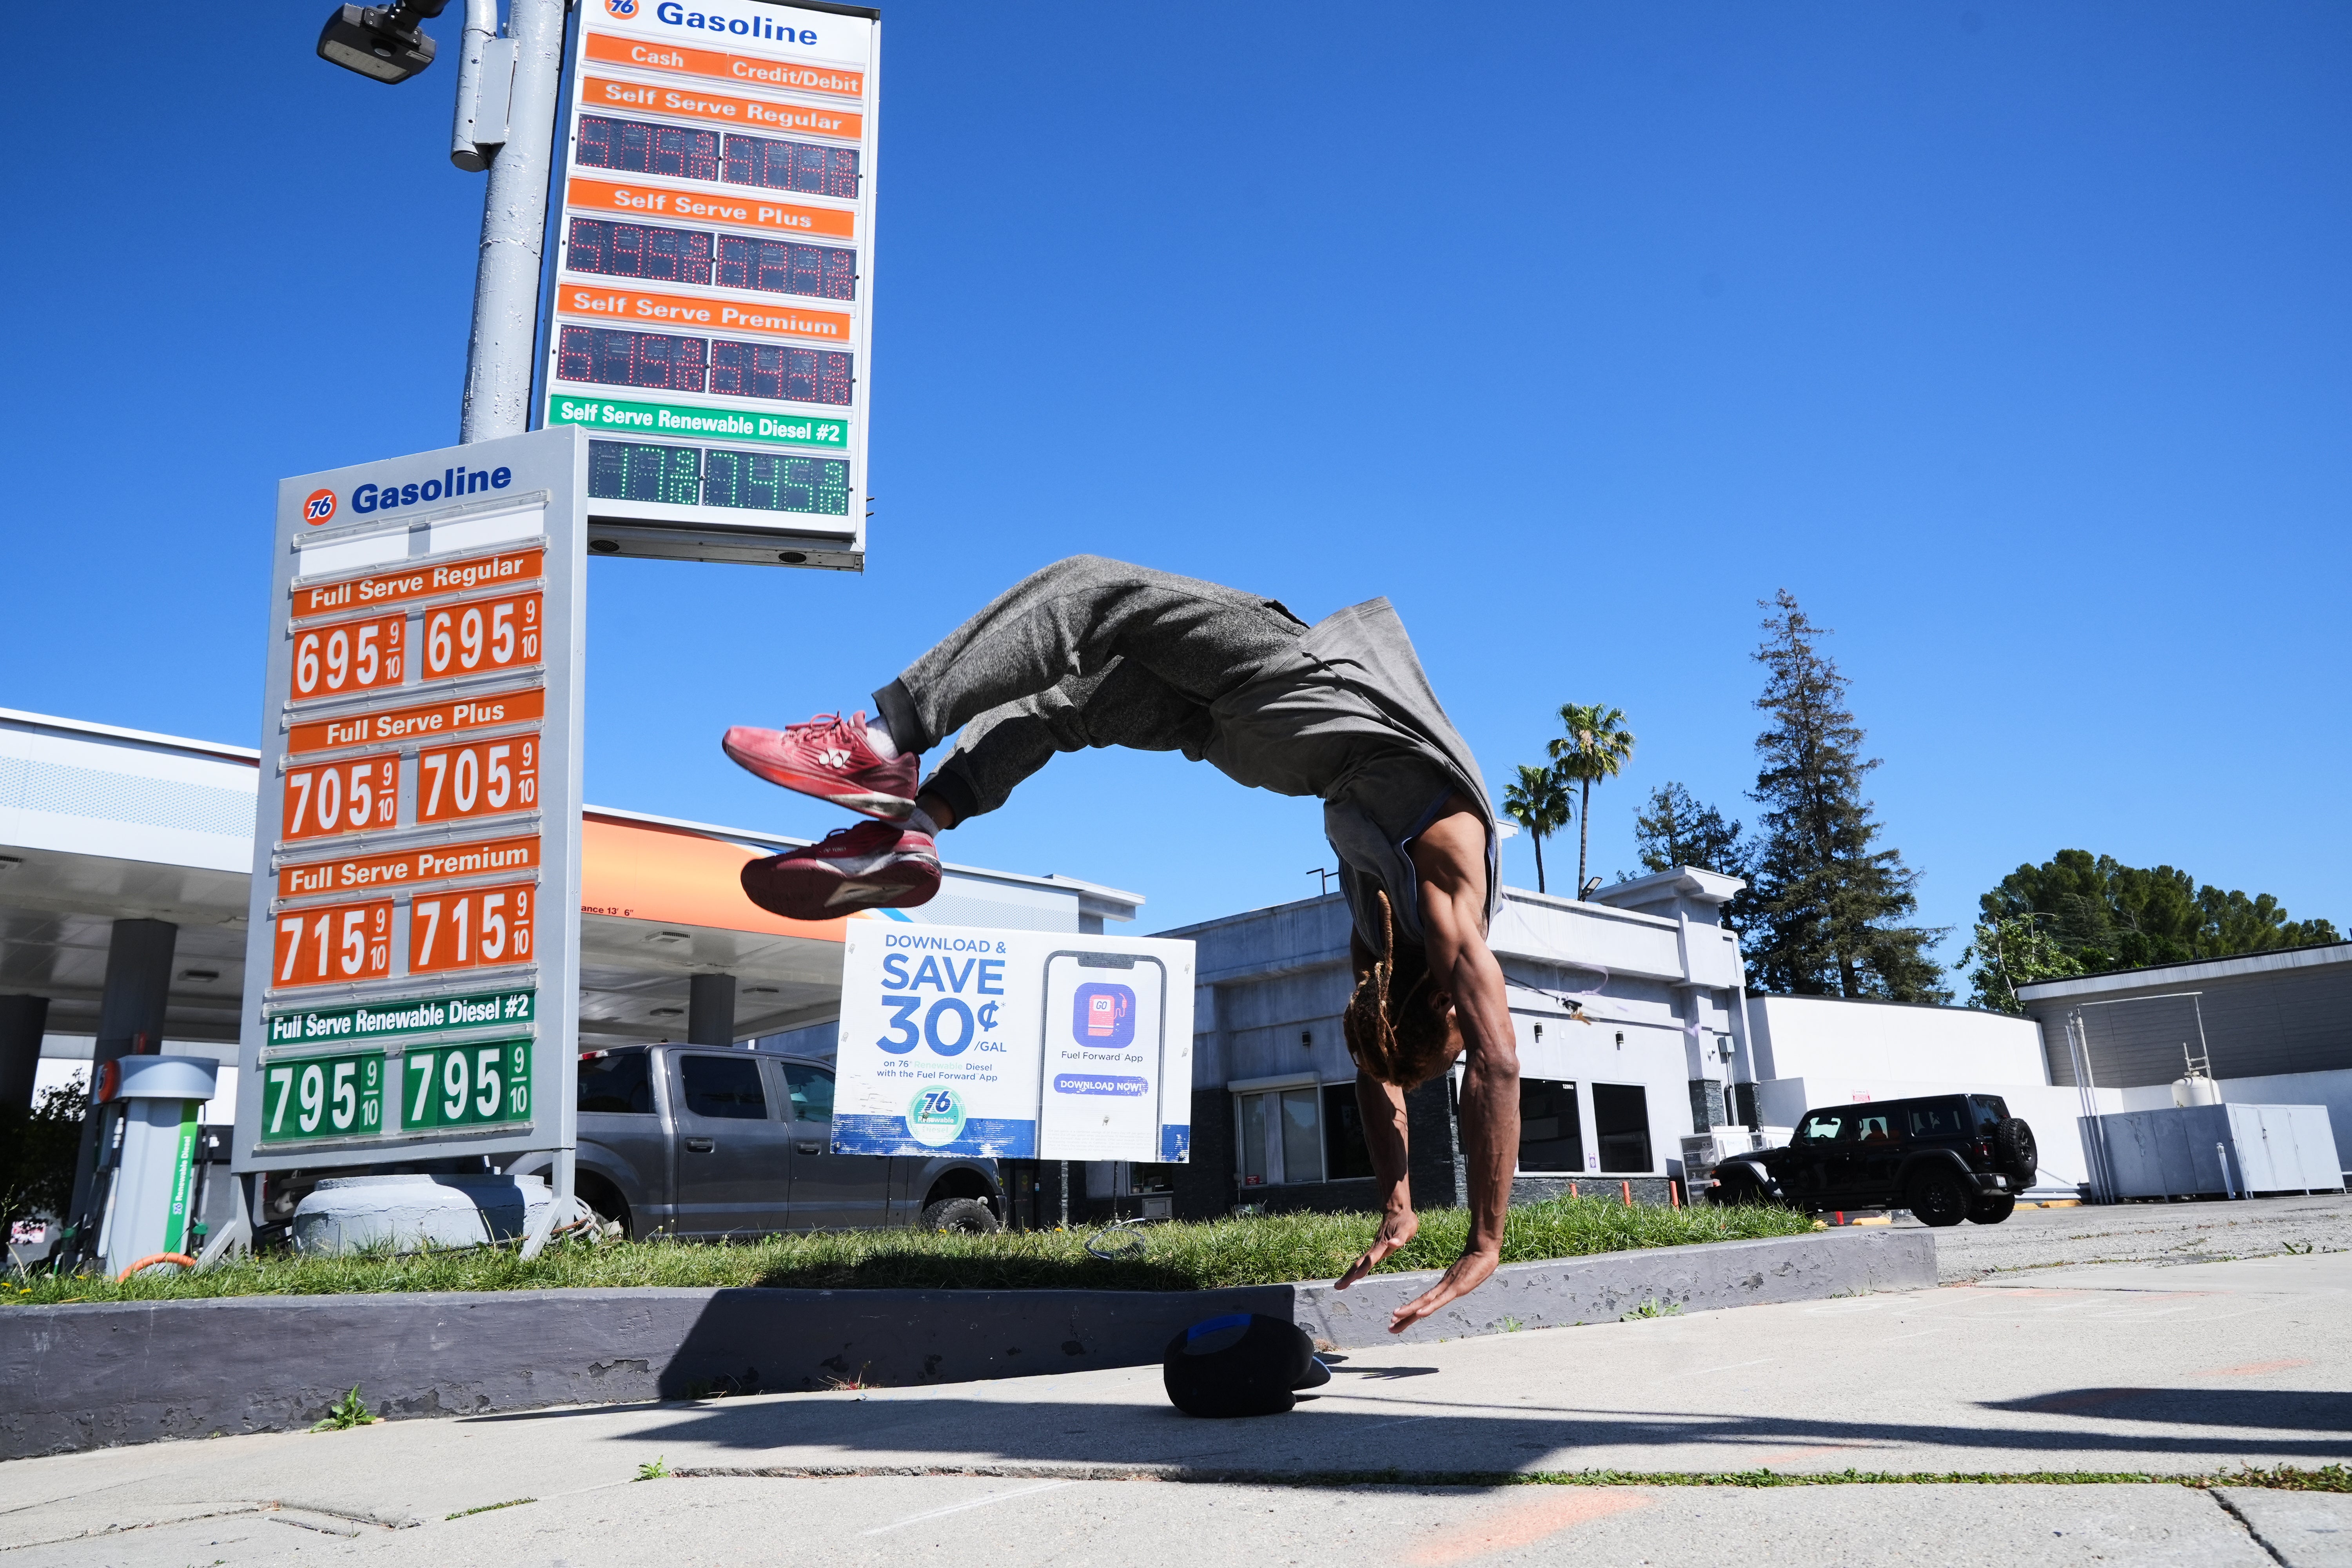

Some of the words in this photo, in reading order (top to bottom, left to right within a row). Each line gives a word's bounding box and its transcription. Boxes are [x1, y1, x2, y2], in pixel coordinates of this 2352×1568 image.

[609, 0, 634, 14] 76
[657, 2, 817, 45] Gasoline
[632, 46, 683, 67] Cash
[733, 62, 858, 91] Credit/Debit
[606, 84, 656, 104] Self
[666, 93, 736, 116] Serve
[748, 104, 842, 129] Regular
[615, 190, 666, 210] Self
[675, 197, 746, 220] Serve
[759, 207, 811, 227] Plus
[574, 292, 627, 312] Self
[637, 299, 710, 321] Serve
[722, 307, 837, 334] Premium
[561, 402, 598, 421] Self
[603, 405, 653, 426] Serve
[659, 410, 753, 434] Renewable
[759, 423, 811, 439] Diesel
[816, 424, 839, 441] #2
[307, 495, 333, 519] 76
[352, 466, 511, 514] Gasoline
[311, 584, 350, 608] Full
[359, 577, 423, 599] Serve
[434, 558, 523, 587] Regular
[298, 625, 378, 693] 695
[429, 603, 514, 671] 695
[328, 719, 368, 744] Full
[377, 715, 442, 737] Serve
[454, 703, 504, 725] Plus
[291, 764, 371, 833] 705
[425, 745, 510, 815] 705
[291, 867, 332, 891] Full
[341, 864, 407, 885] Serve
[419, 847, 528, 875] Premium
[281, 910, 365, 980] 715
[417, 893, 505, 965] 715
[886, 935, 990, 952] DOWNLOAD
[996, 942, 1005, 953] &
[881, 953, 1005, 995] SAVE
[274, 1015, 301, 1039] Full
[306, 1014, 351, 1036] Serve
[356, 1003, 444, 1032] Renewable
[450, 996, 499, 1023] Diesel
[505, 995, 528, 1018] #2
[1096, 1001, 1107, 1009] GO
[914, 1061, 962, 1070] Renewable
[974, 1042, 1006, 1052] /GAL
[270, 1062, 355, 1132] 795
[411, 1049, 500, 1120] 795
[925, 1091, 951, 1112] 76
[1060, 1080, 1114, 1091] DOWNLOAD
[175, 1160, 187, 1201] Renewable
[181, 1136, 191, 1159] Diesel
